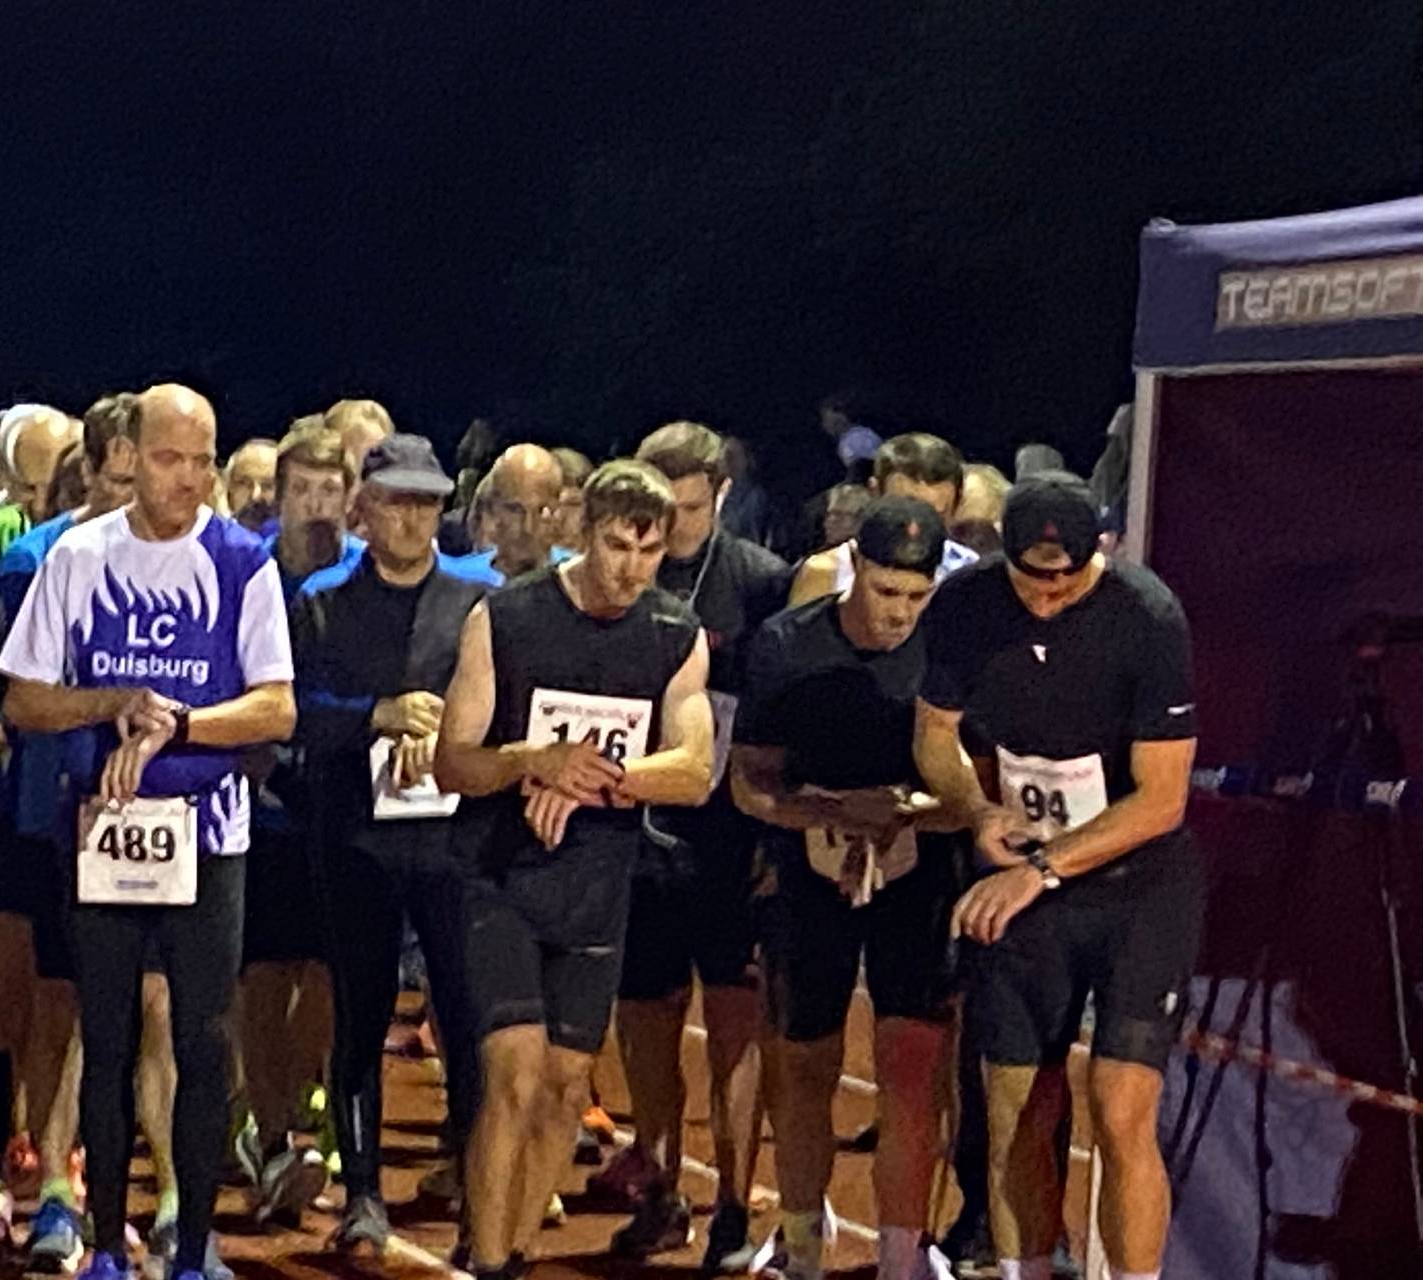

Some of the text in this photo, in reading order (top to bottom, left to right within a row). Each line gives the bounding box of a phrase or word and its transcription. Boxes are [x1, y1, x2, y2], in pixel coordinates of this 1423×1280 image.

[127, 613, 177, 648] LC
[91, 650, 210, 687] Duisburg
[1020, 784, 1070, 827] 94
[96, 824, 176, 862] 489
